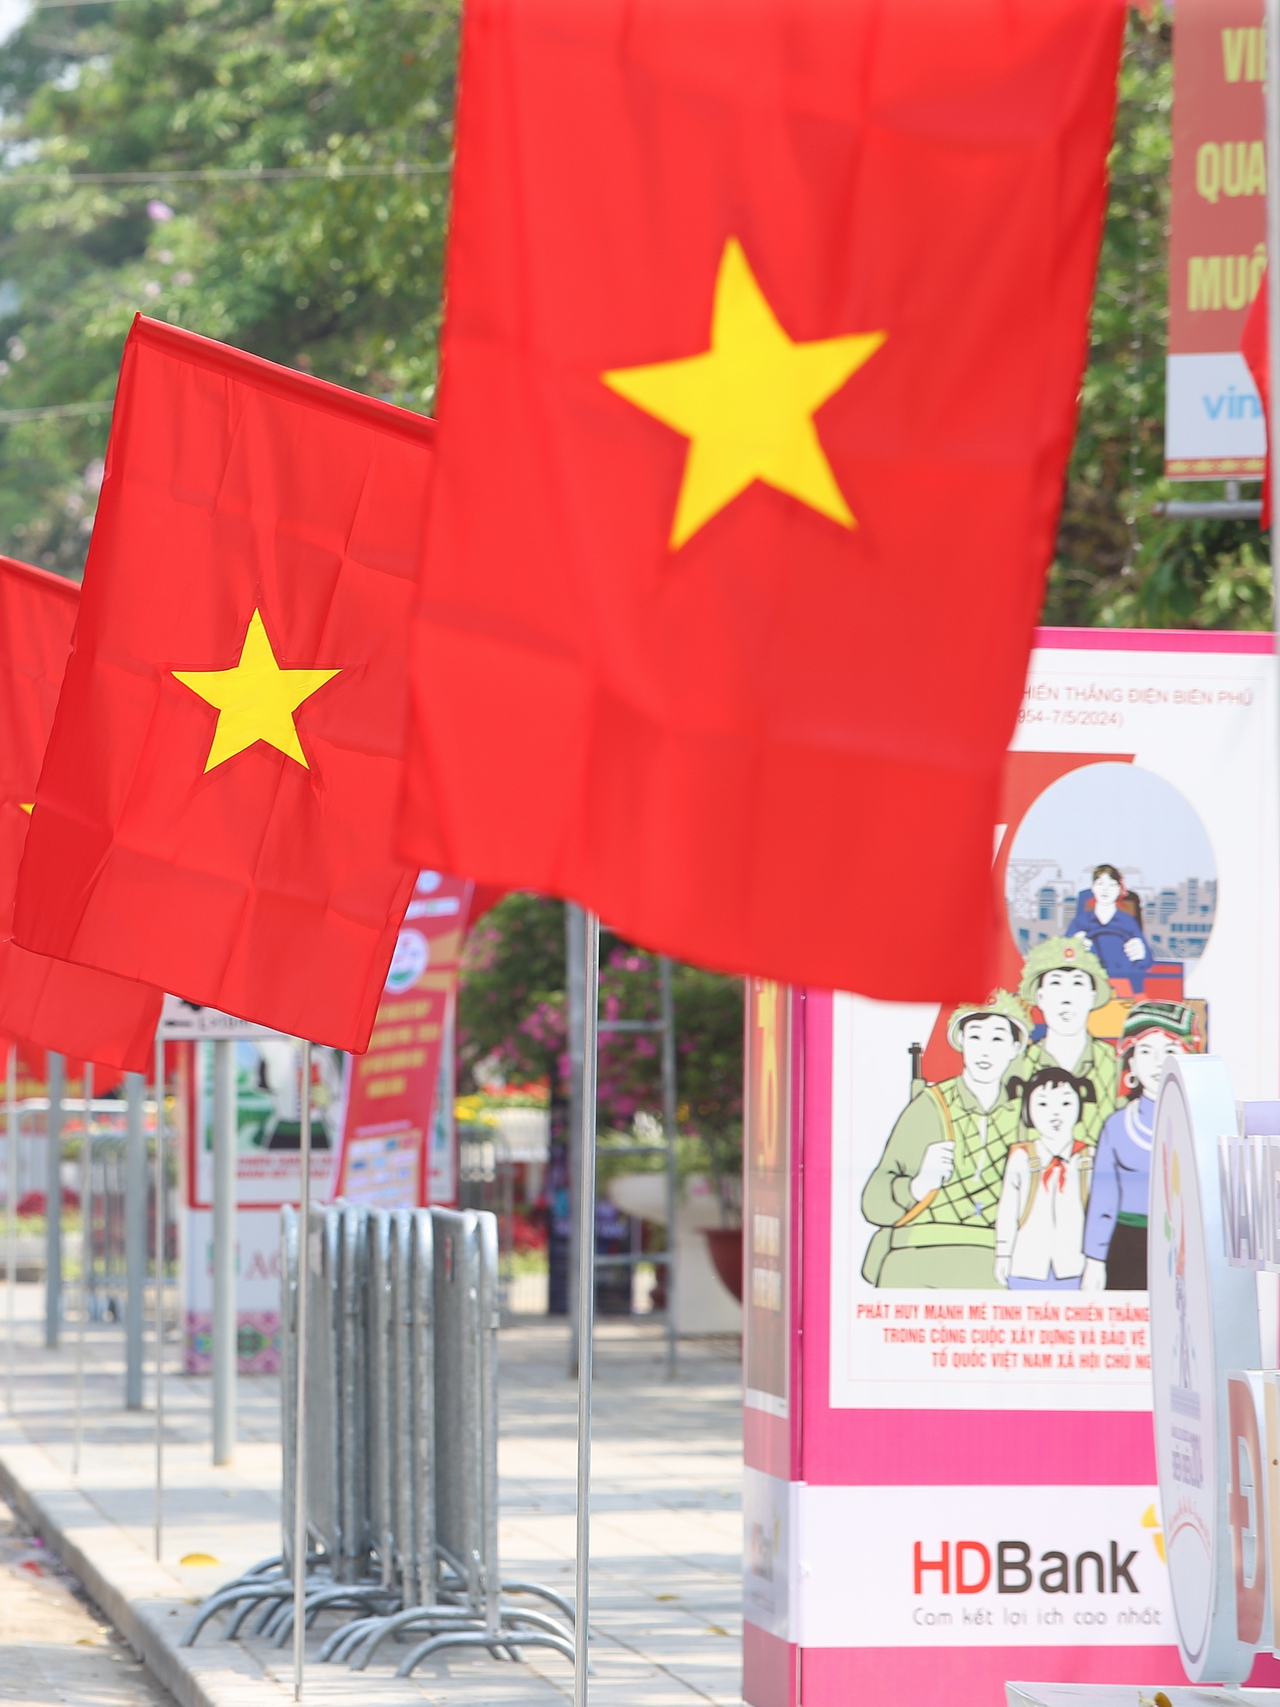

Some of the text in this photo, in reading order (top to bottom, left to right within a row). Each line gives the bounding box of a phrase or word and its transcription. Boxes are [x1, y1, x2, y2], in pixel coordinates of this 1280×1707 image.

[1065, 683, 1123, 703] THẮNG
[857, 1301, 890, 1319] PHÁT
[894, 1304, 919, 1320] HUY
[924, 1304, 964, 1323] MẠNH
[993, 1305, 1022, 1320] TINH
[1065, 1301, 1104, 1321] CHIẾN
[883, 1327, 926, 1343] TRONG
[930, 1325, 967, 1344] CÔNG
[971, 1326, 1006, 1348] CUỘC
[1010, 1326, 1035, 1344] XÂY
[952, 1346, 987, 1368] QUỐC
[991, 1350, 1018, 1371] VIỆT
[1023, 1354, 1052, 1368] NAM
[1079, 1352, 1100, 1372] HỘI
[1105, 1347, 1131, 1369] CHỦ
[914, 1541, 1140, 1594] HDBank
[913, 1607, 953, 1626] Cam
[962, 1606, 993, 1625] kết
[1074, 1610, 1107, 1626] cao
